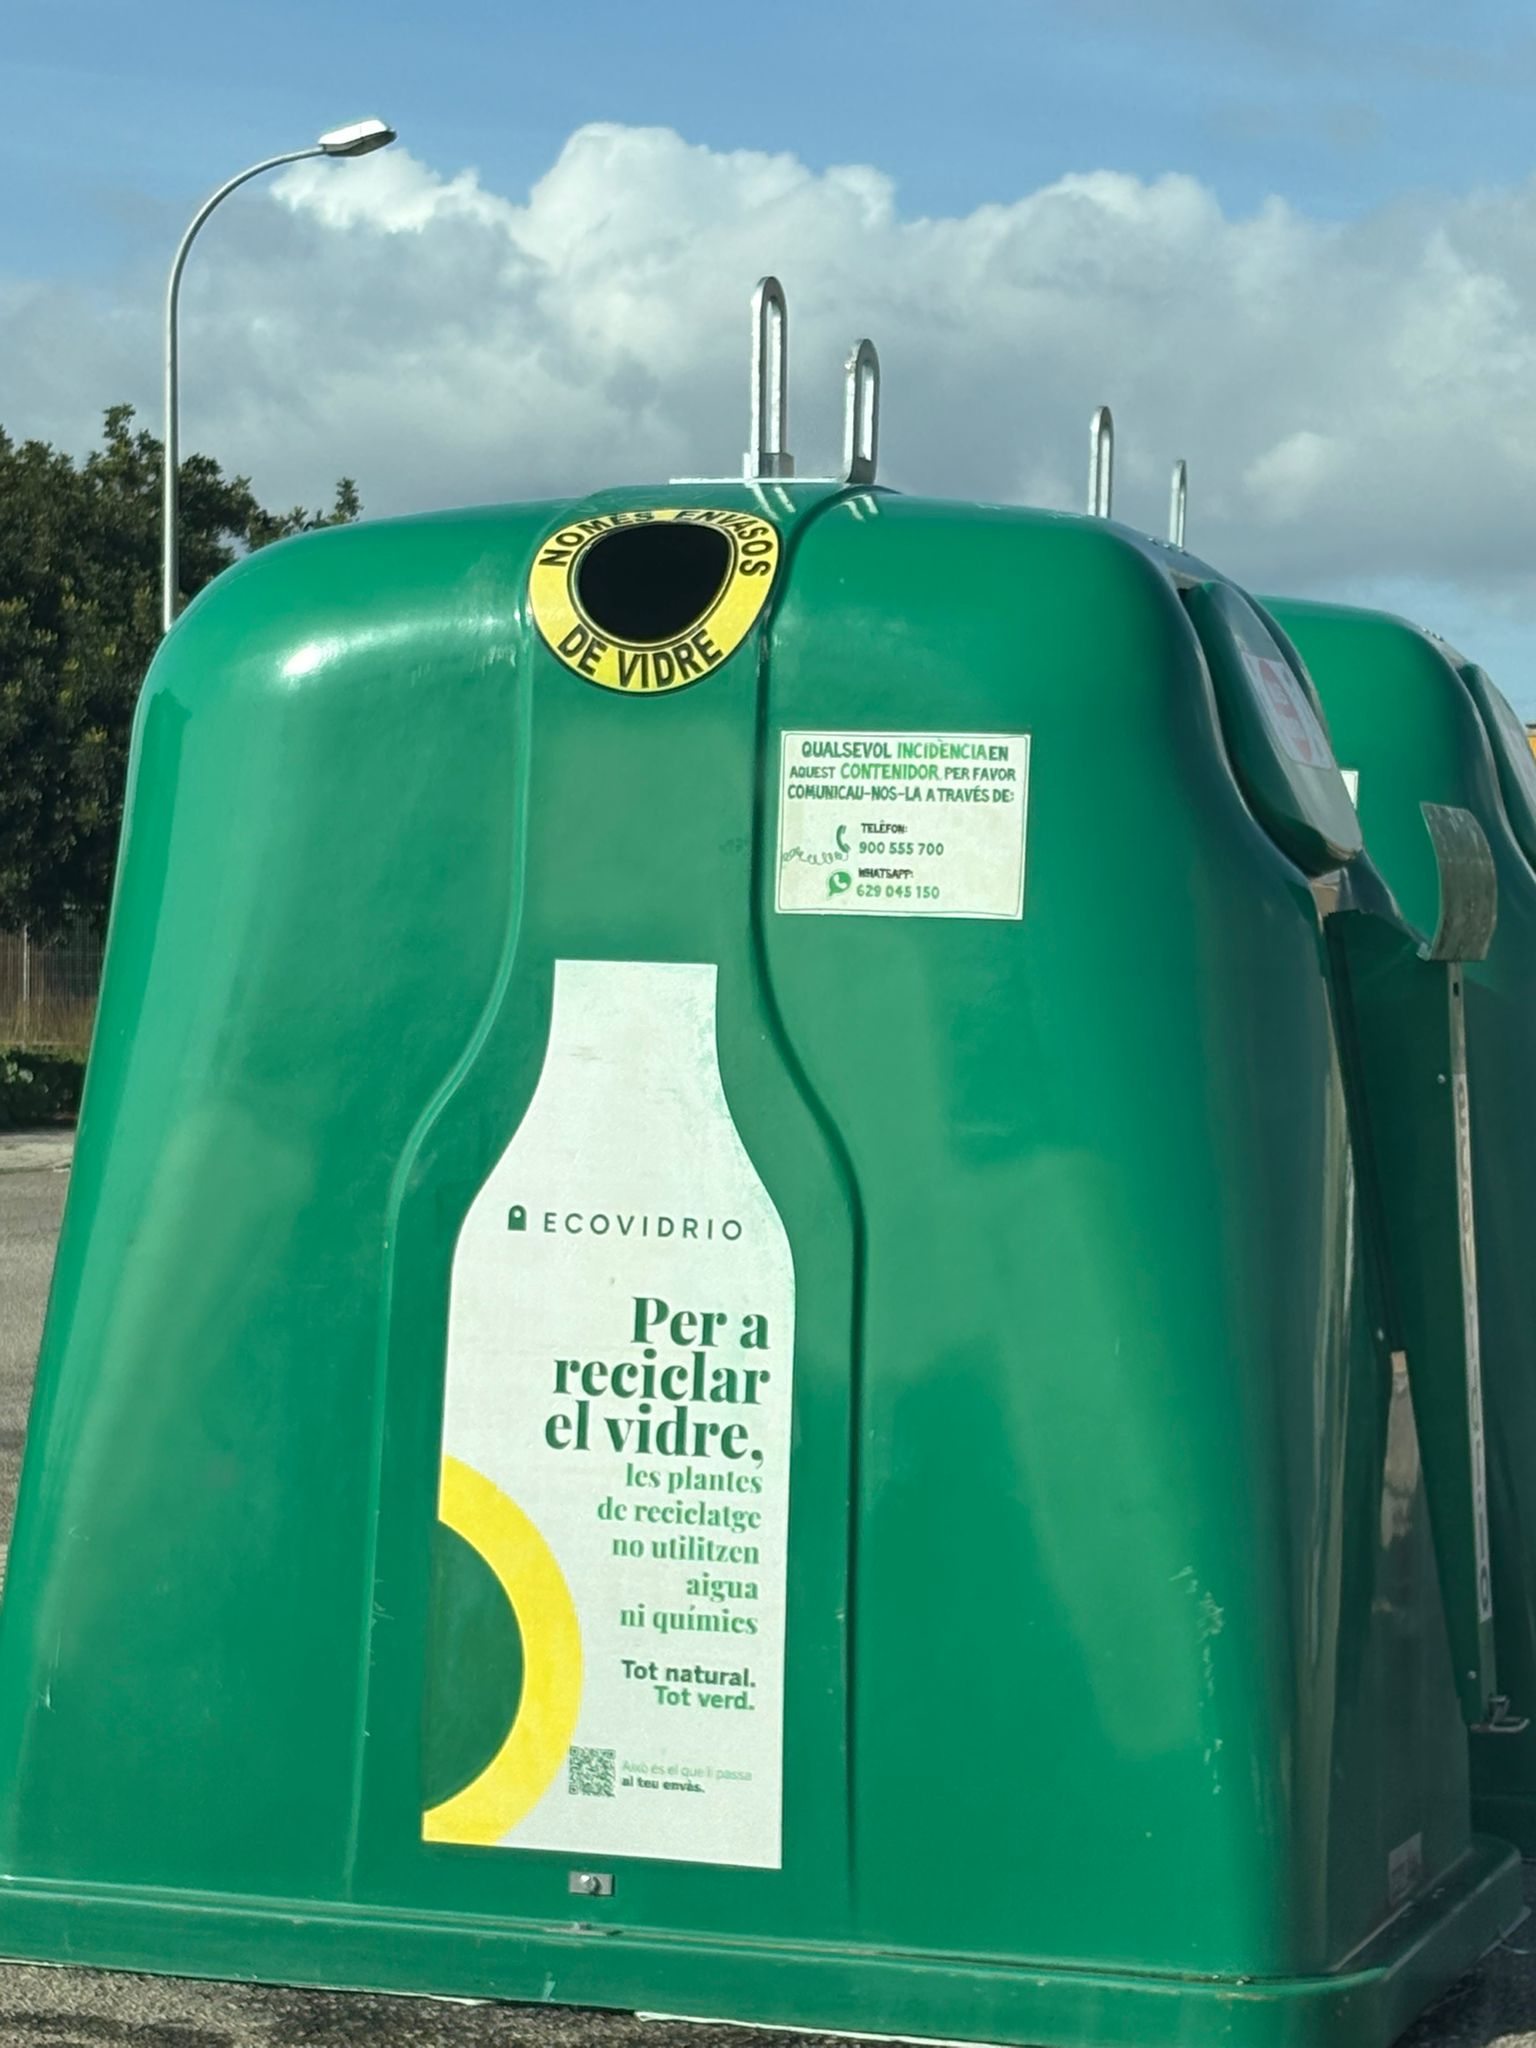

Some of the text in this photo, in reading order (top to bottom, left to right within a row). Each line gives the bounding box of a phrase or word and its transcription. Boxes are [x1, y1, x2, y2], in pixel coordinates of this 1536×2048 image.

[672, 510, 774, 577] ENVASOS
[557, 624, 723, 688] DE VIDRE
[801, 741, 892, 759] QUALSEVOL
[988, 745, 1009, 761] EN
[789, 766, 836, 779] AQUEST
[944, 766, 970, 780] PER
[972, 767, 1017, 781] FAVOR
[787, 784, 1015, 803] COMUNICAU-NOS-LA A TRAVÉS DE:
[858, 841, 945, 856] 900 555 700
[856, 884, 940, 899] 629 045 150
[543, 1211, 742, 1241] ECOVIDRIO
[630, 1296, 771, 1350] Per a
[553, 1348, 771, 1405] reciclar
[544, 1400, 764, 1469] el vidre,
[625, 1462, 763, 1494] les plantes
[597, 1496, 762, 1533] de reciclatge
[612, 1535, 760, 1564] no utilitzen
[686, 1572, 759, 1603] aigua
[620, 1603, 759, 1635] ni químics
[621, 1659, 757, 1688] Tot natural.
[653, 1685, 755, 1711] Tot verd.
[621, 1775, 634, 1787] al
[637, 1777, 659, 1789] teu
[716, 1769, 752, 1781] passa
